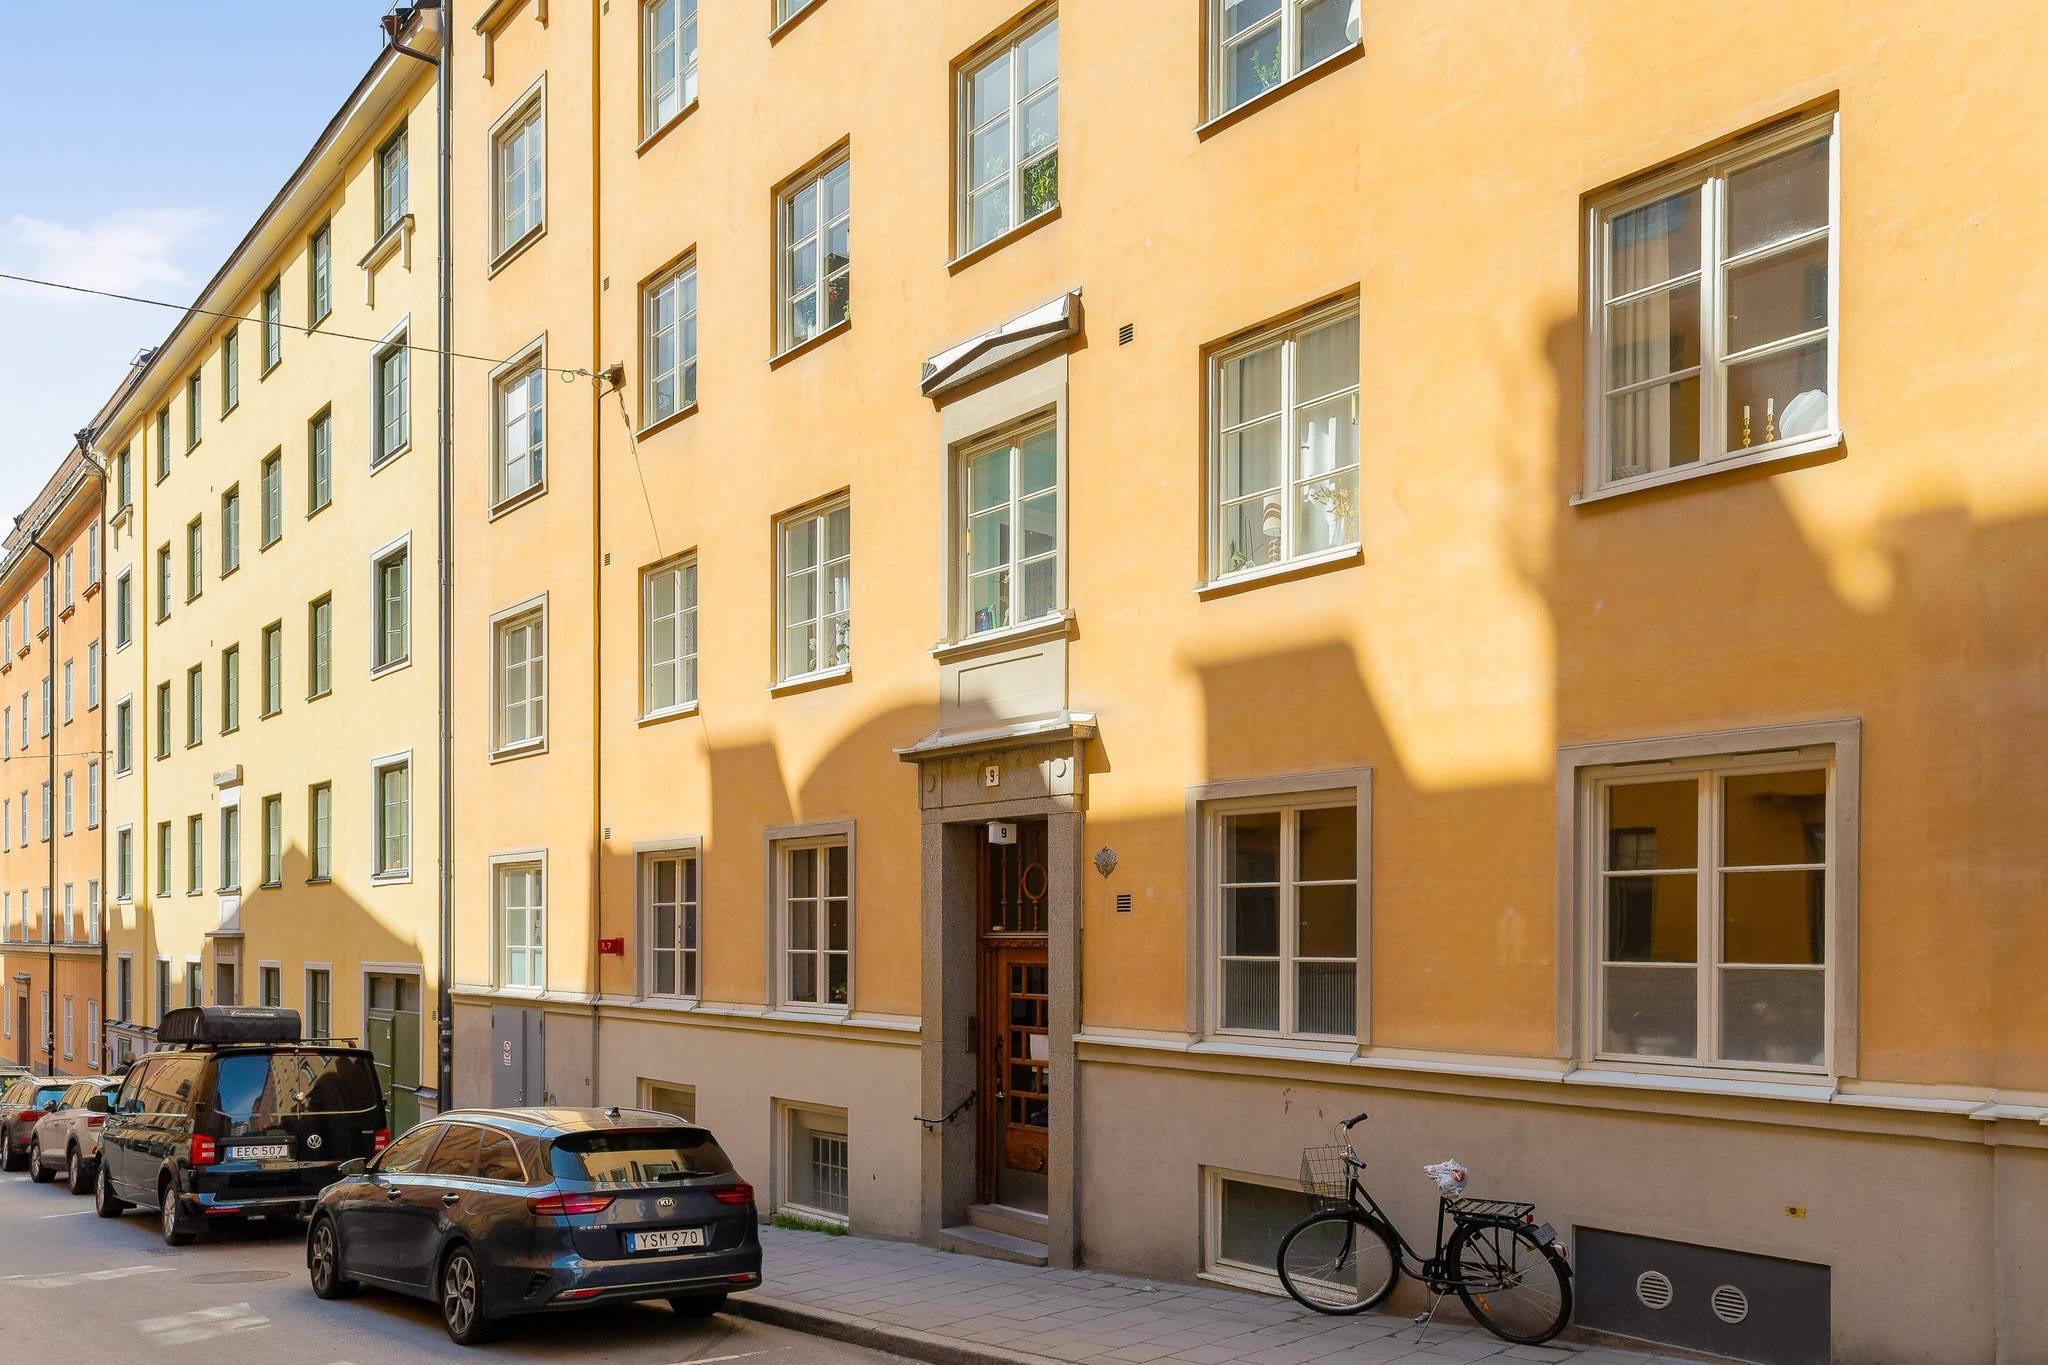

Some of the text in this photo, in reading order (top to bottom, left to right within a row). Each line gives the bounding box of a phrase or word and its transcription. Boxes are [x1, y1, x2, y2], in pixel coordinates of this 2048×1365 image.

[990, 770, 994, 782] 9
[1001, 828, 1007, 838] 9
[237, 1146, 283, 1157] EEC 507
[640, 1231, 698, 1248] YSM 970
